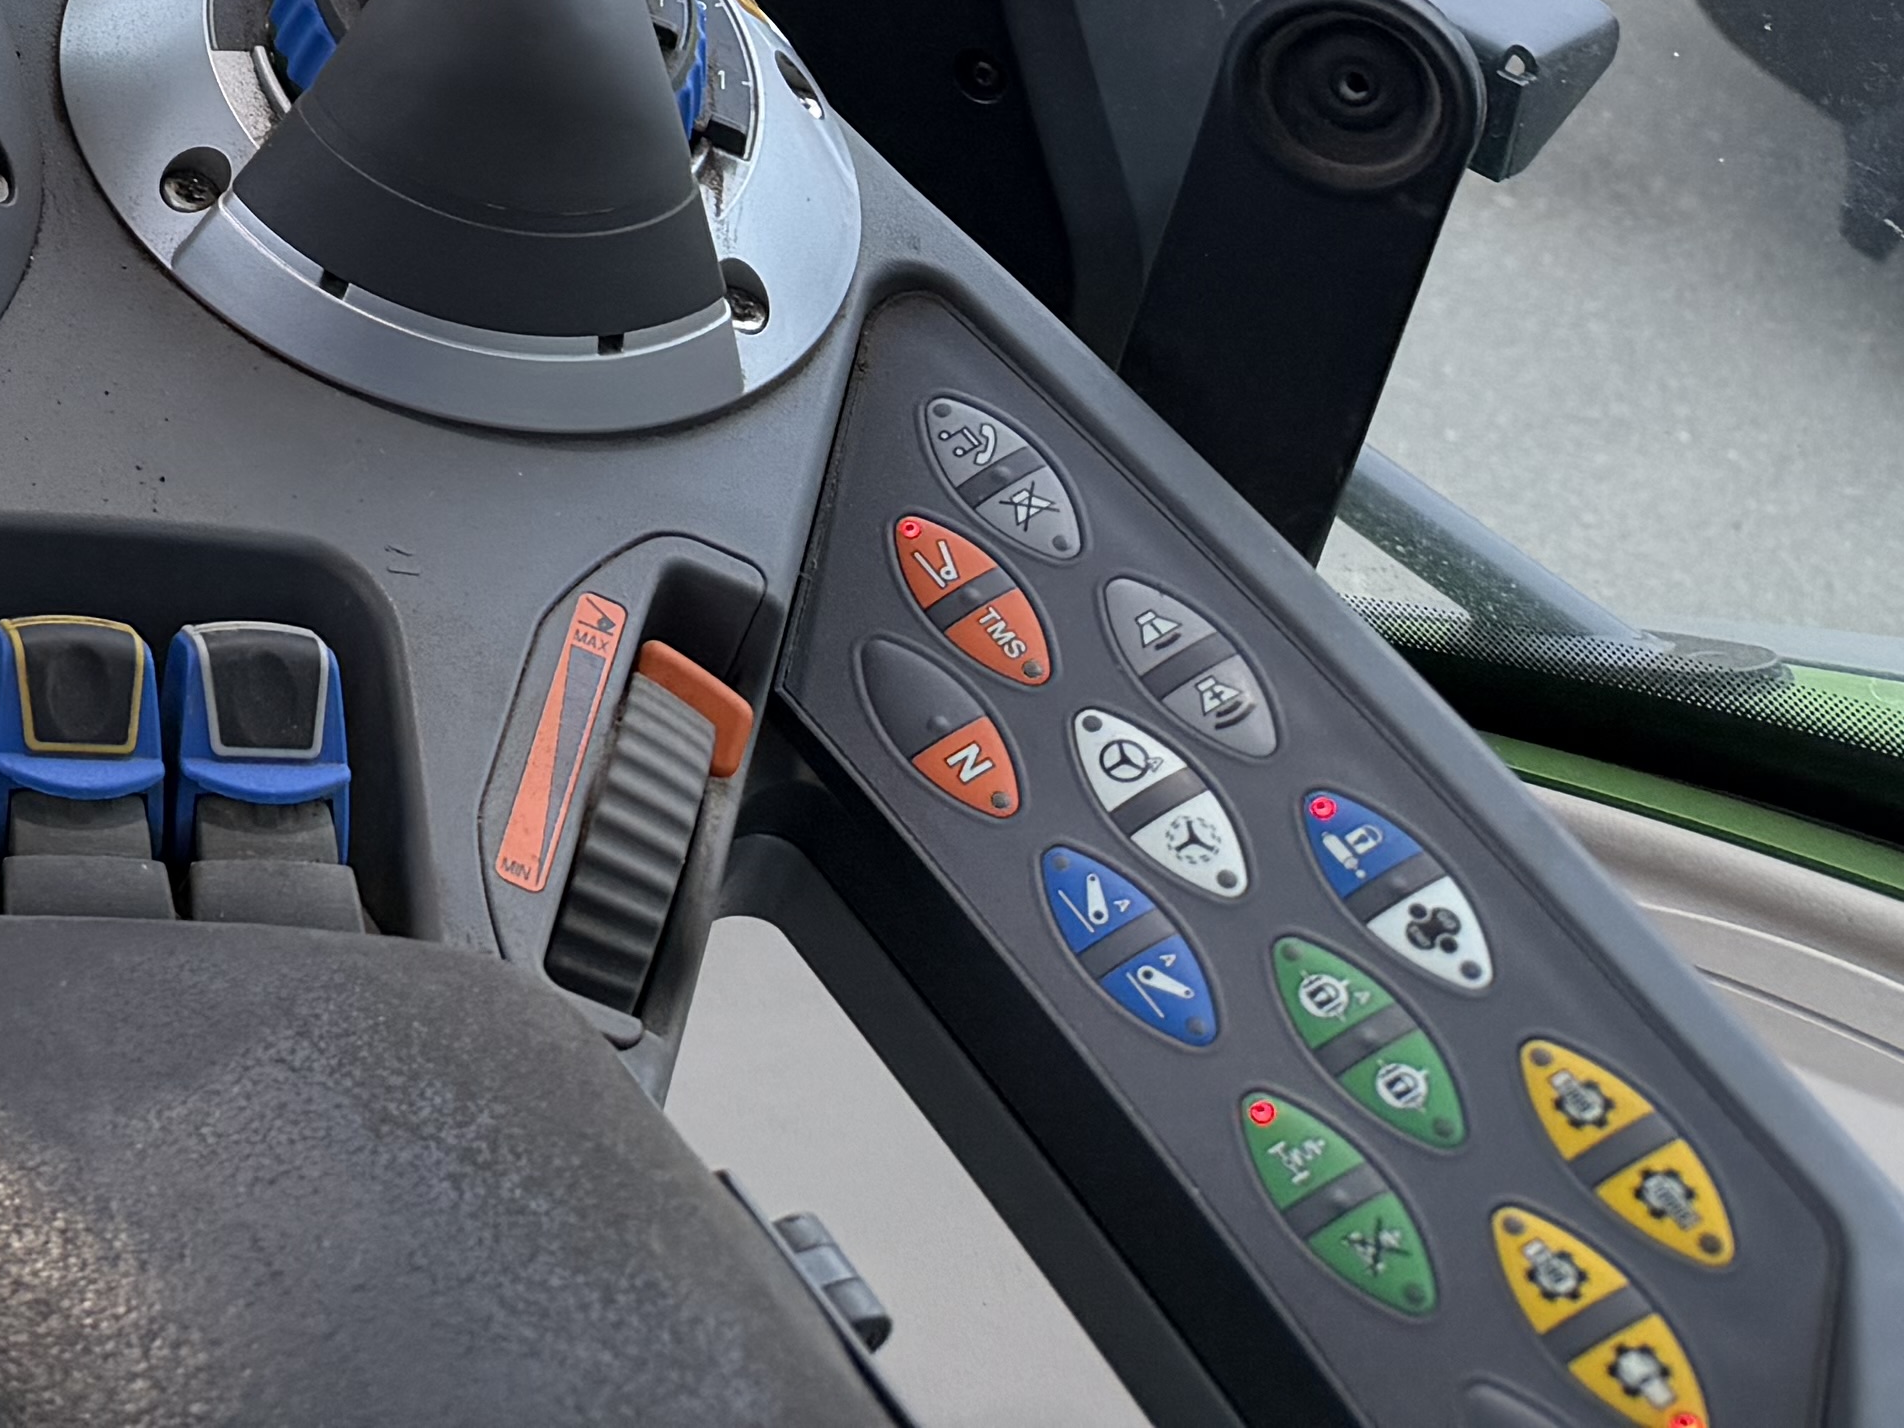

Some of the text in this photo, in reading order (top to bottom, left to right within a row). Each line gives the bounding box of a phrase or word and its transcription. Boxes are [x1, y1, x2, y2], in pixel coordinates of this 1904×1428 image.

[573, 629, 609, 653] MAX
[978, 607, 1027, 659] TMS
[946, 740, 996, 784] N
[500, 856, 533, 883] MIN
